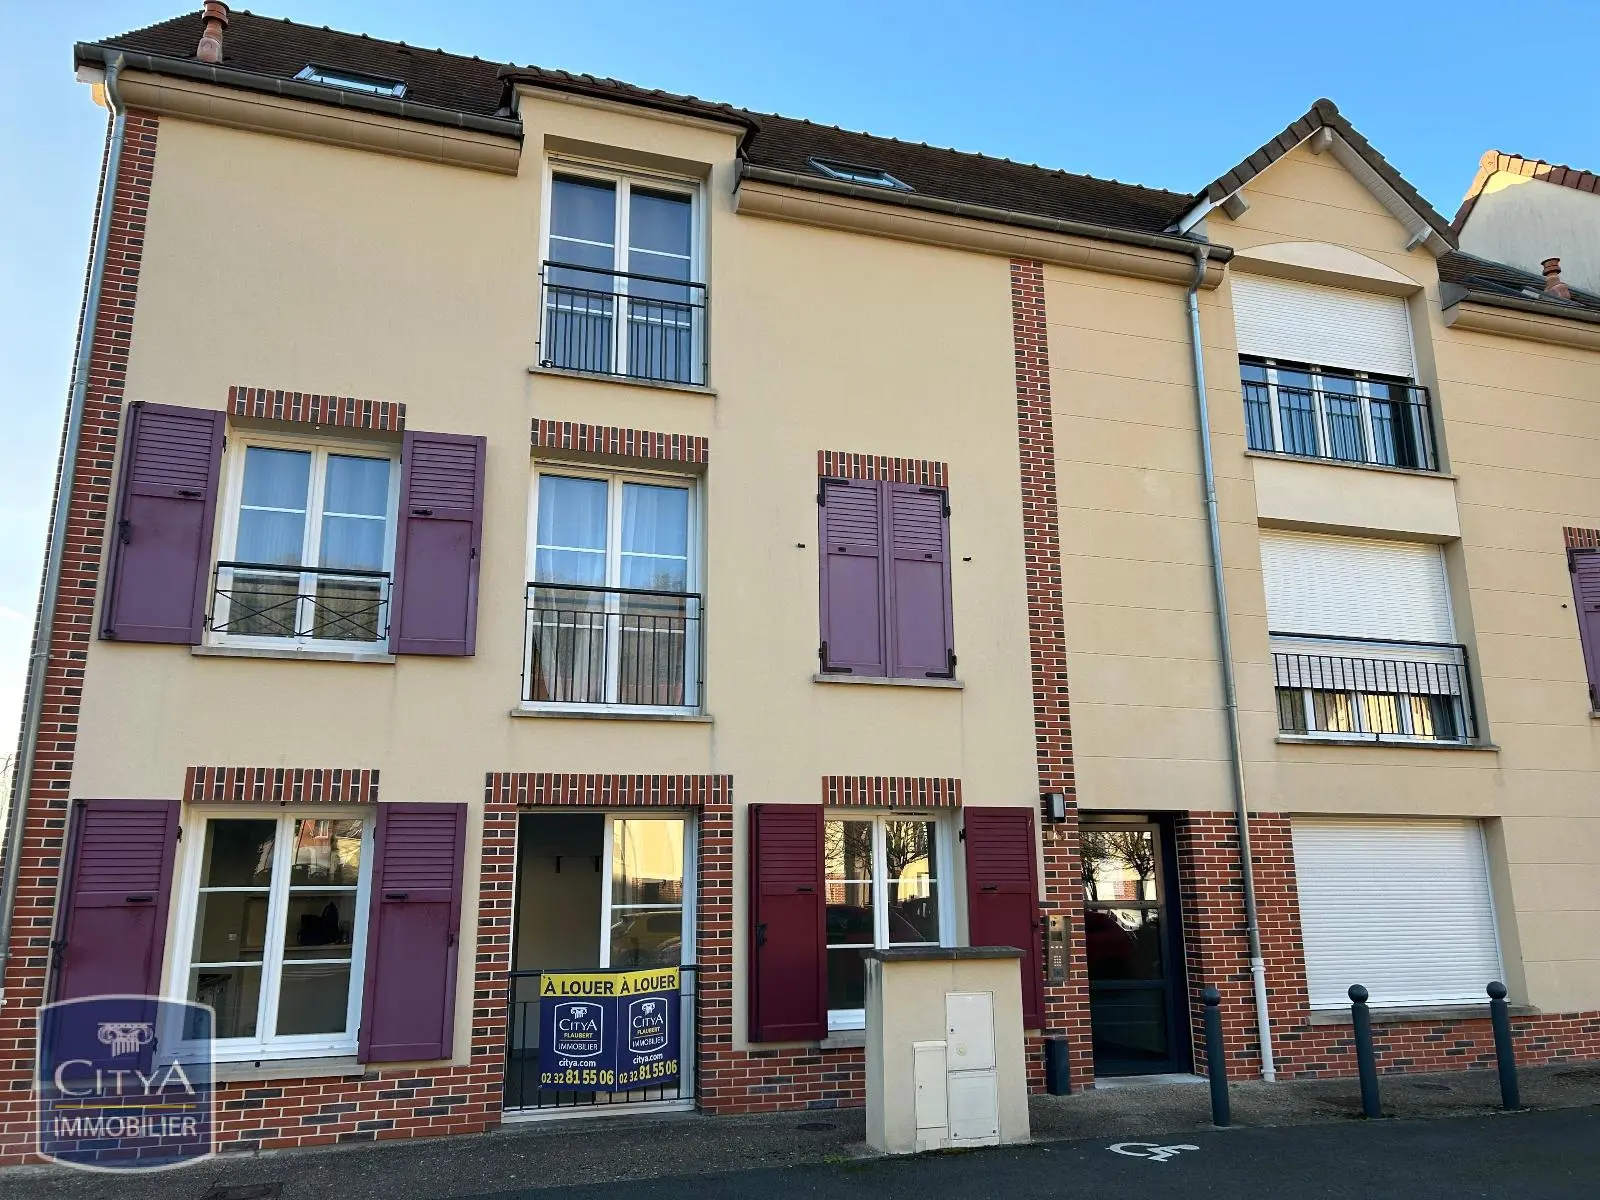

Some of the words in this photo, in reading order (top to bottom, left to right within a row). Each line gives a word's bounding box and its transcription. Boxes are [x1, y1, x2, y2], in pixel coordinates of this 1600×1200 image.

[544, 977, 556, 994] À
[561, 981, 613, 994] LOUER
[620, 977, 630, 994] À
[634, 975, 675, 992] LOUER
[637, 1027, 660, 1035] FLAUBERT
[633, 1036, 664, 1047] IMMOBILIER
[559, 1058, 596, 1068] citya.com
[633, 1053, 663, 1065] citya.com
[542, 1073, 551, 1083] 02
[554, 1073, 564, 1083] 32
[566, 1069, 580, 1084] 81
[583, 1070, 596, 1084] 55
[600, 1070, 614, 1084] 06
[619, 1073, 627, 1084] 02
[630, 1071, 638, 1081] 32
[639, 1065, 651, 1080] 81
[653, 1062, 664, 1077] 55
[666, 1060, 677, 1074] 06
